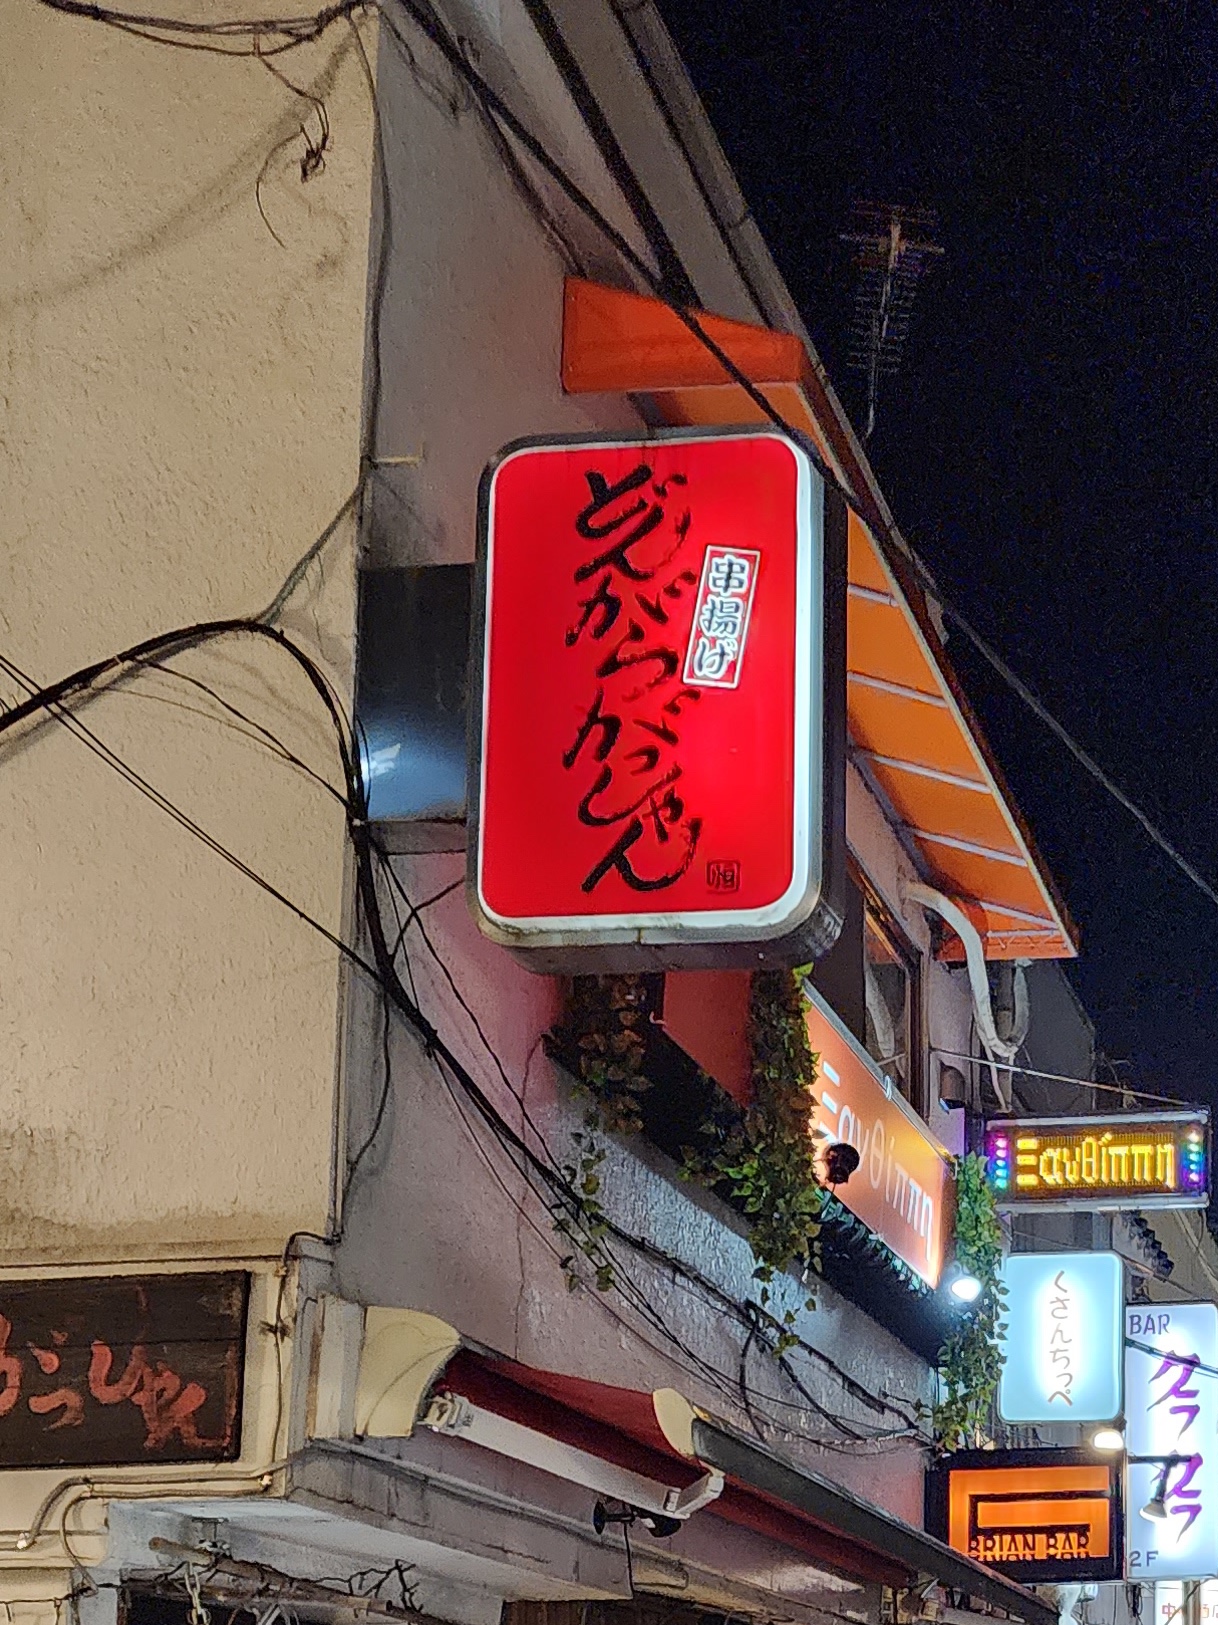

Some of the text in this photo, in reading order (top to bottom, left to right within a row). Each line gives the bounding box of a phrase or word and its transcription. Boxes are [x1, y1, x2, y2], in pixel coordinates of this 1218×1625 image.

[693, 554, 749, 681] 串揚げ
[1129, 1313, 1170, 1336] BAR
[968, 1532, 1090, 1562] BRIAN BAR
[1129, 1550, 1159, 1567] 2F
